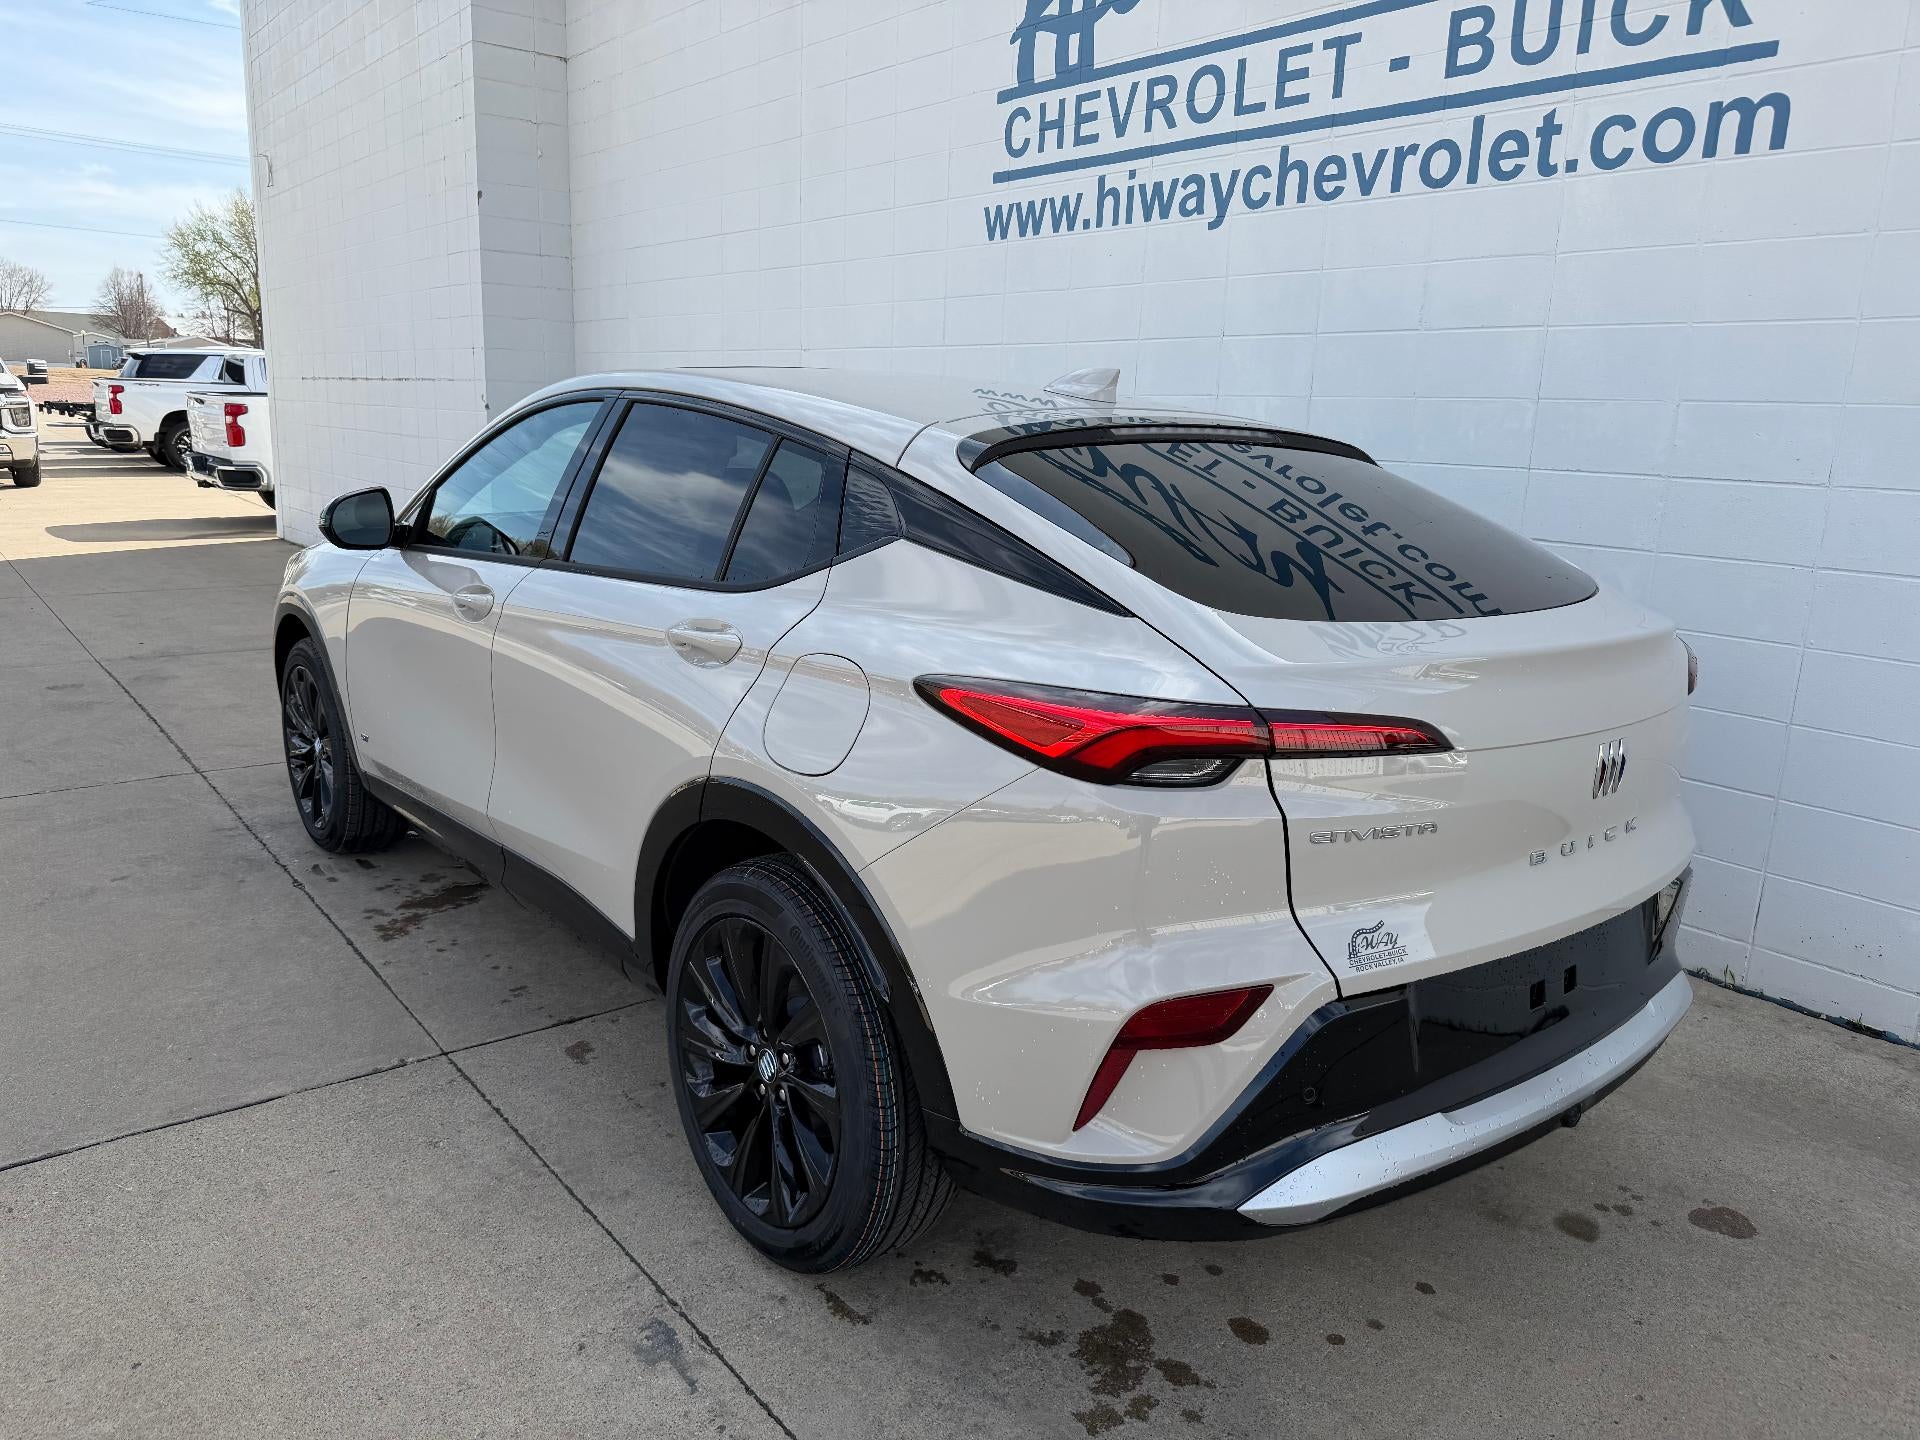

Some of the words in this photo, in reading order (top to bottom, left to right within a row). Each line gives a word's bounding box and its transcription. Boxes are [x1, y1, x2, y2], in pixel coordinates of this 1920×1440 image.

[1004, 32, 1363, 159] CHEVROLET
[983, 91, 1792, 242] www.hiwaychevrolet.com
[1309, 821, 1438, 844] ENVISTA
[1529, 816, 1638, 867] BUICK
[1355, 963, 1374, 972] ROCK
